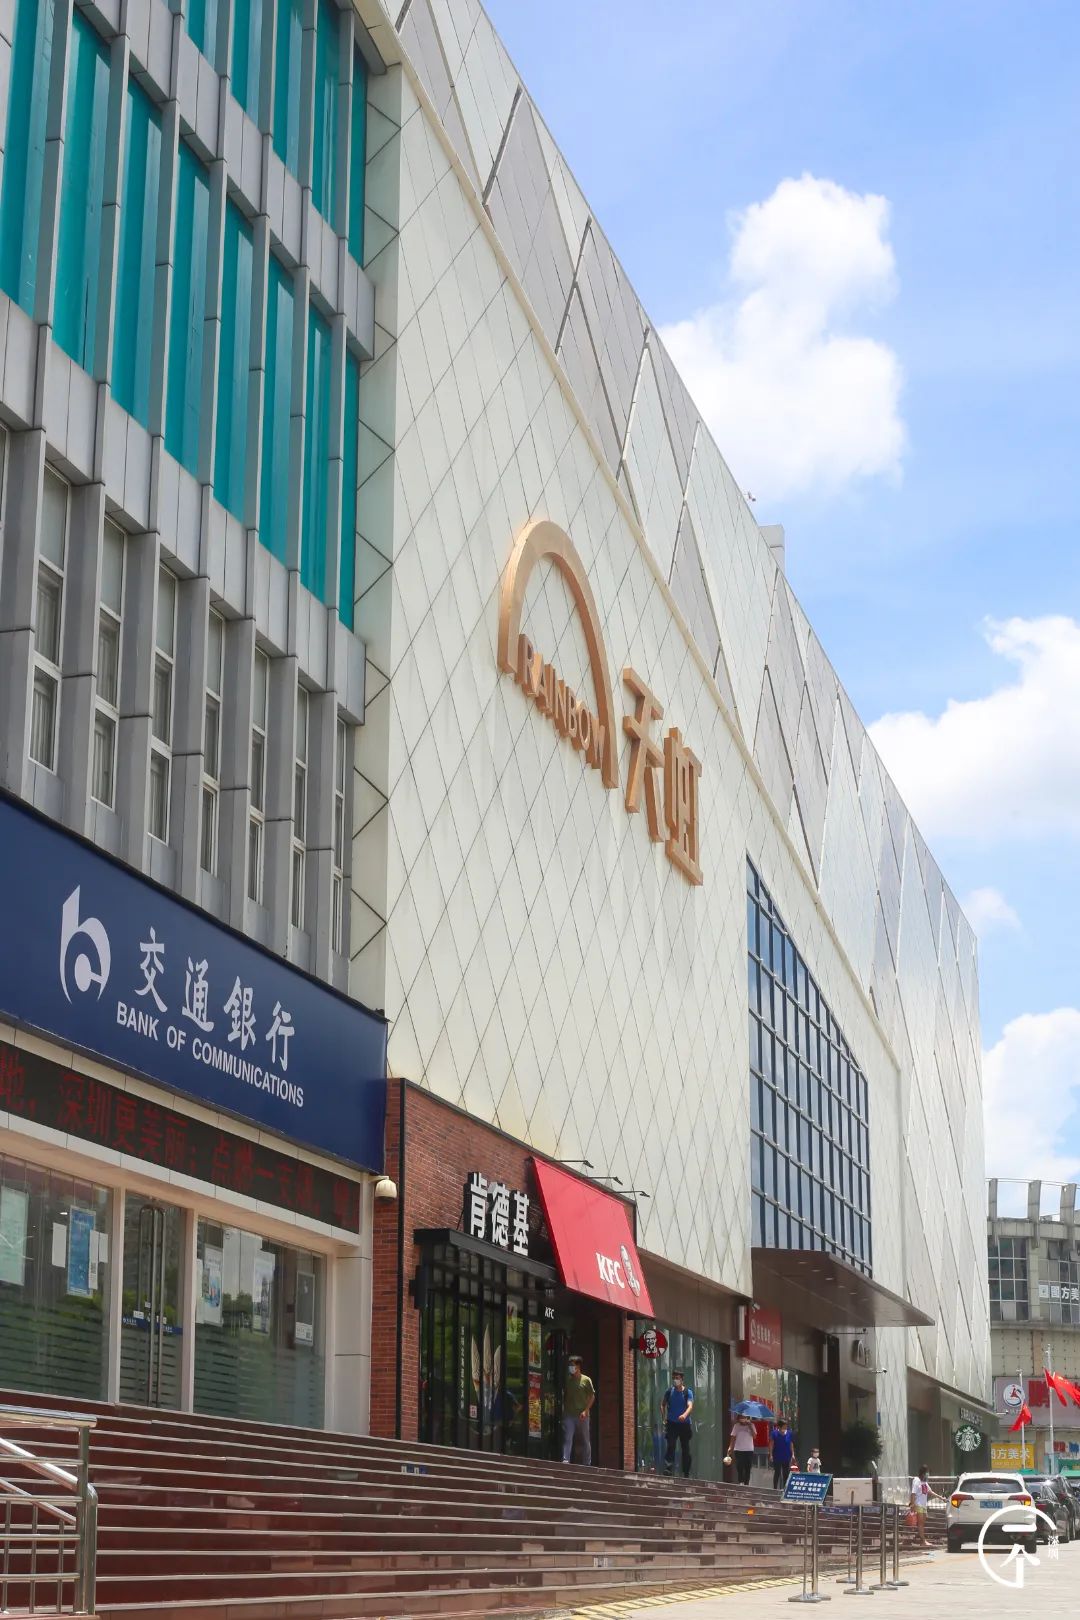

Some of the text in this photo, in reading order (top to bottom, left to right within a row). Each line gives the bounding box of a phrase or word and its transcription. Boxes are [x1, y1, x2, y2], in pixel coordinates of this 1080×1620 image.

[515, 634, 605, 769] RAINBOW
[623, 666, 703, 886] 天虹
[135, 926, 295, 1071] 交通銀行
[117, 1001, 304, 1107] BANK OF COMMUNICATIONS
[464, 1172, 530, 1256] 肯德基
[545, 1306, 555, 1320] KFC
[595, 1252, 625, 1289] KFC
